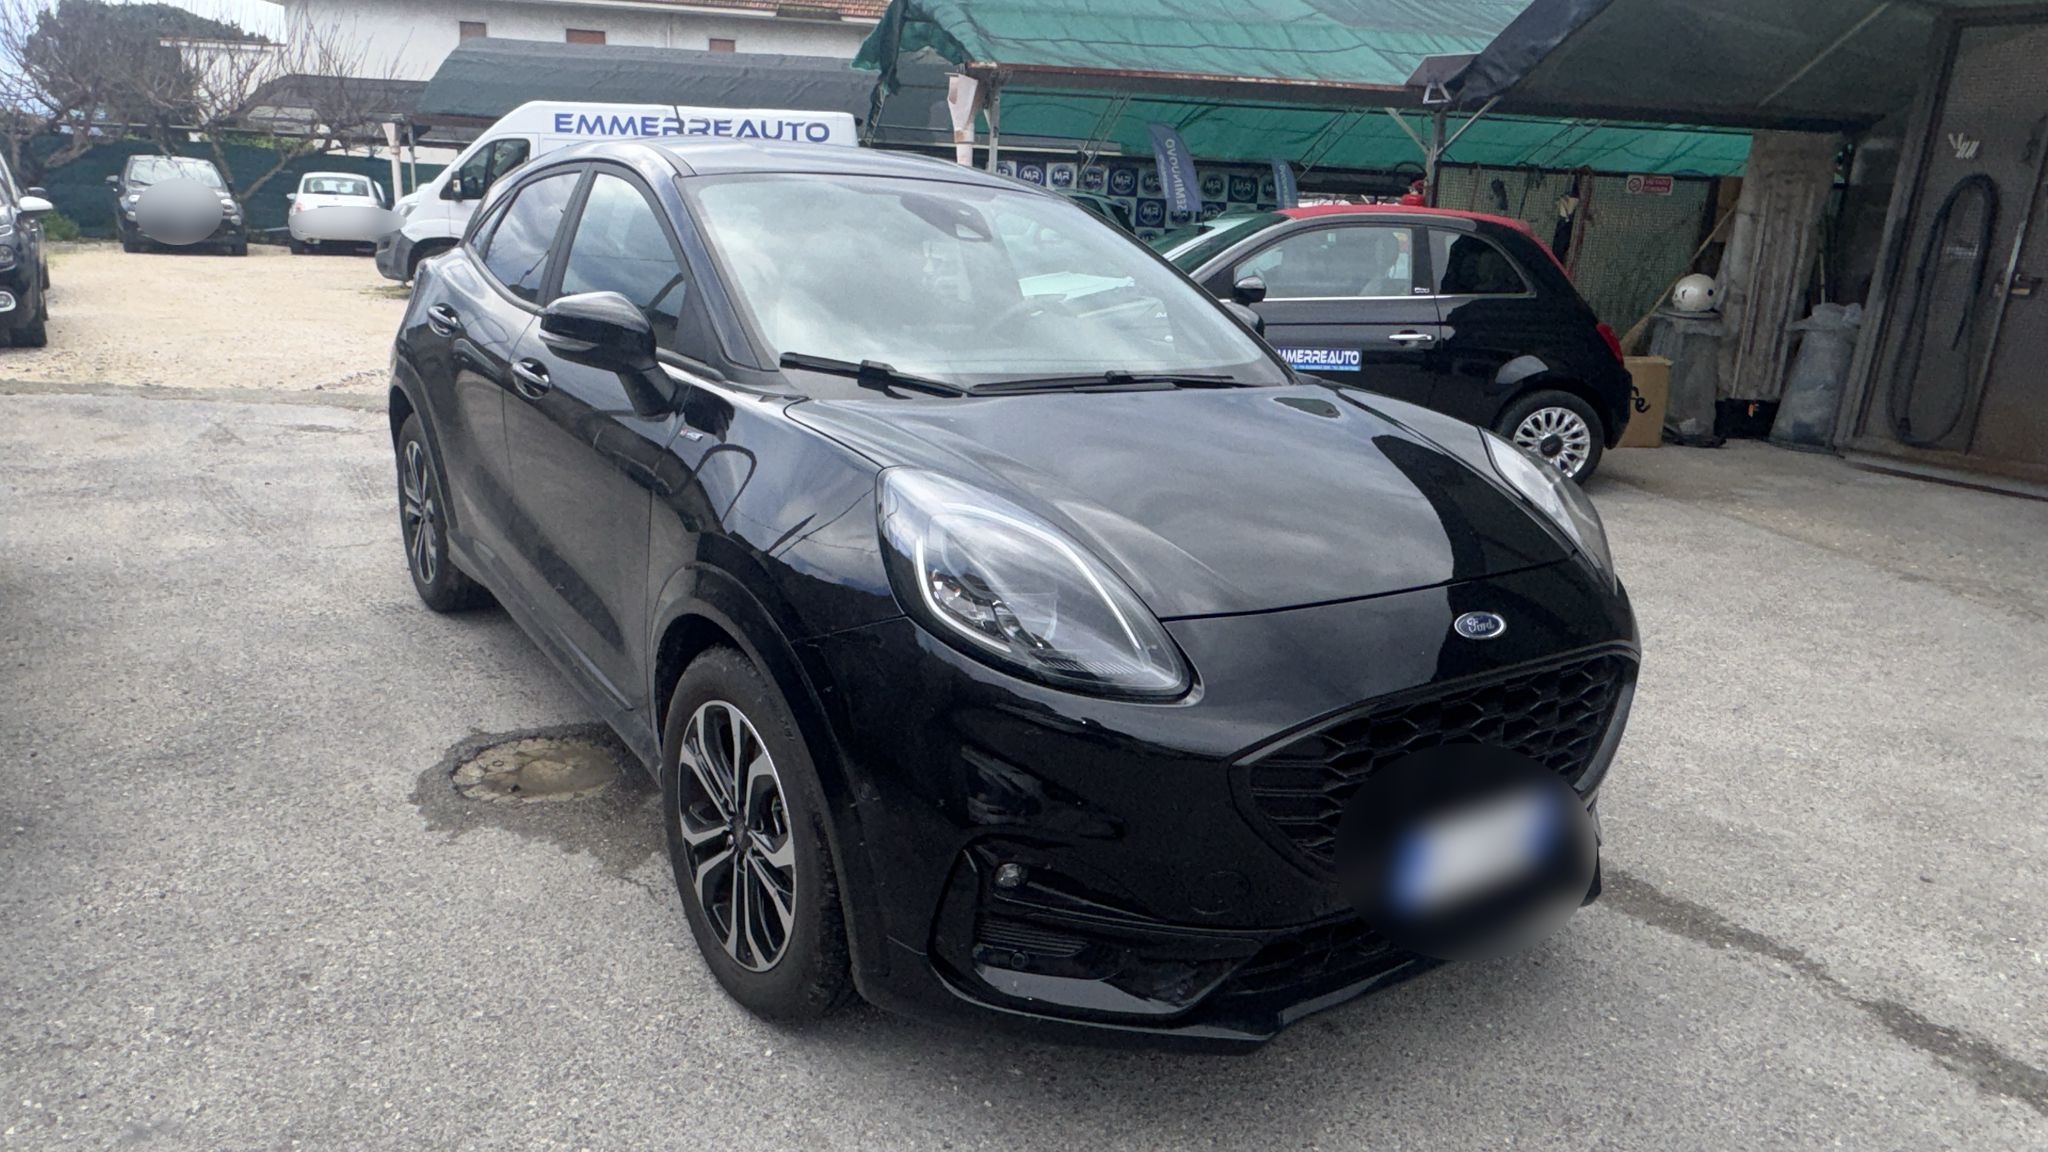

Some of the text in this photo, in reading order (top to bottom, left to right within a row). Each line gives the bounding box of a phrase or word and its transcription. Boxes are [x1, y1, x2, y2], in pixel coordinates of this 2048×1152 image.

[554, 113, 830, 142] EMMERREAUTO
[1023, 170, 1040, 181] MR
[1053, 170, 1070, 181] MR
[1085, 173, 1102, 184] MR
[1114, 175, 1131, 186] MR
[1205, 180, 1221, 190] MR
[1142, 206, 1159, 217] MR
[1277, 349, 1360, 365] MMERREAUTO
[1466, 617, 1495, 633] Ford
